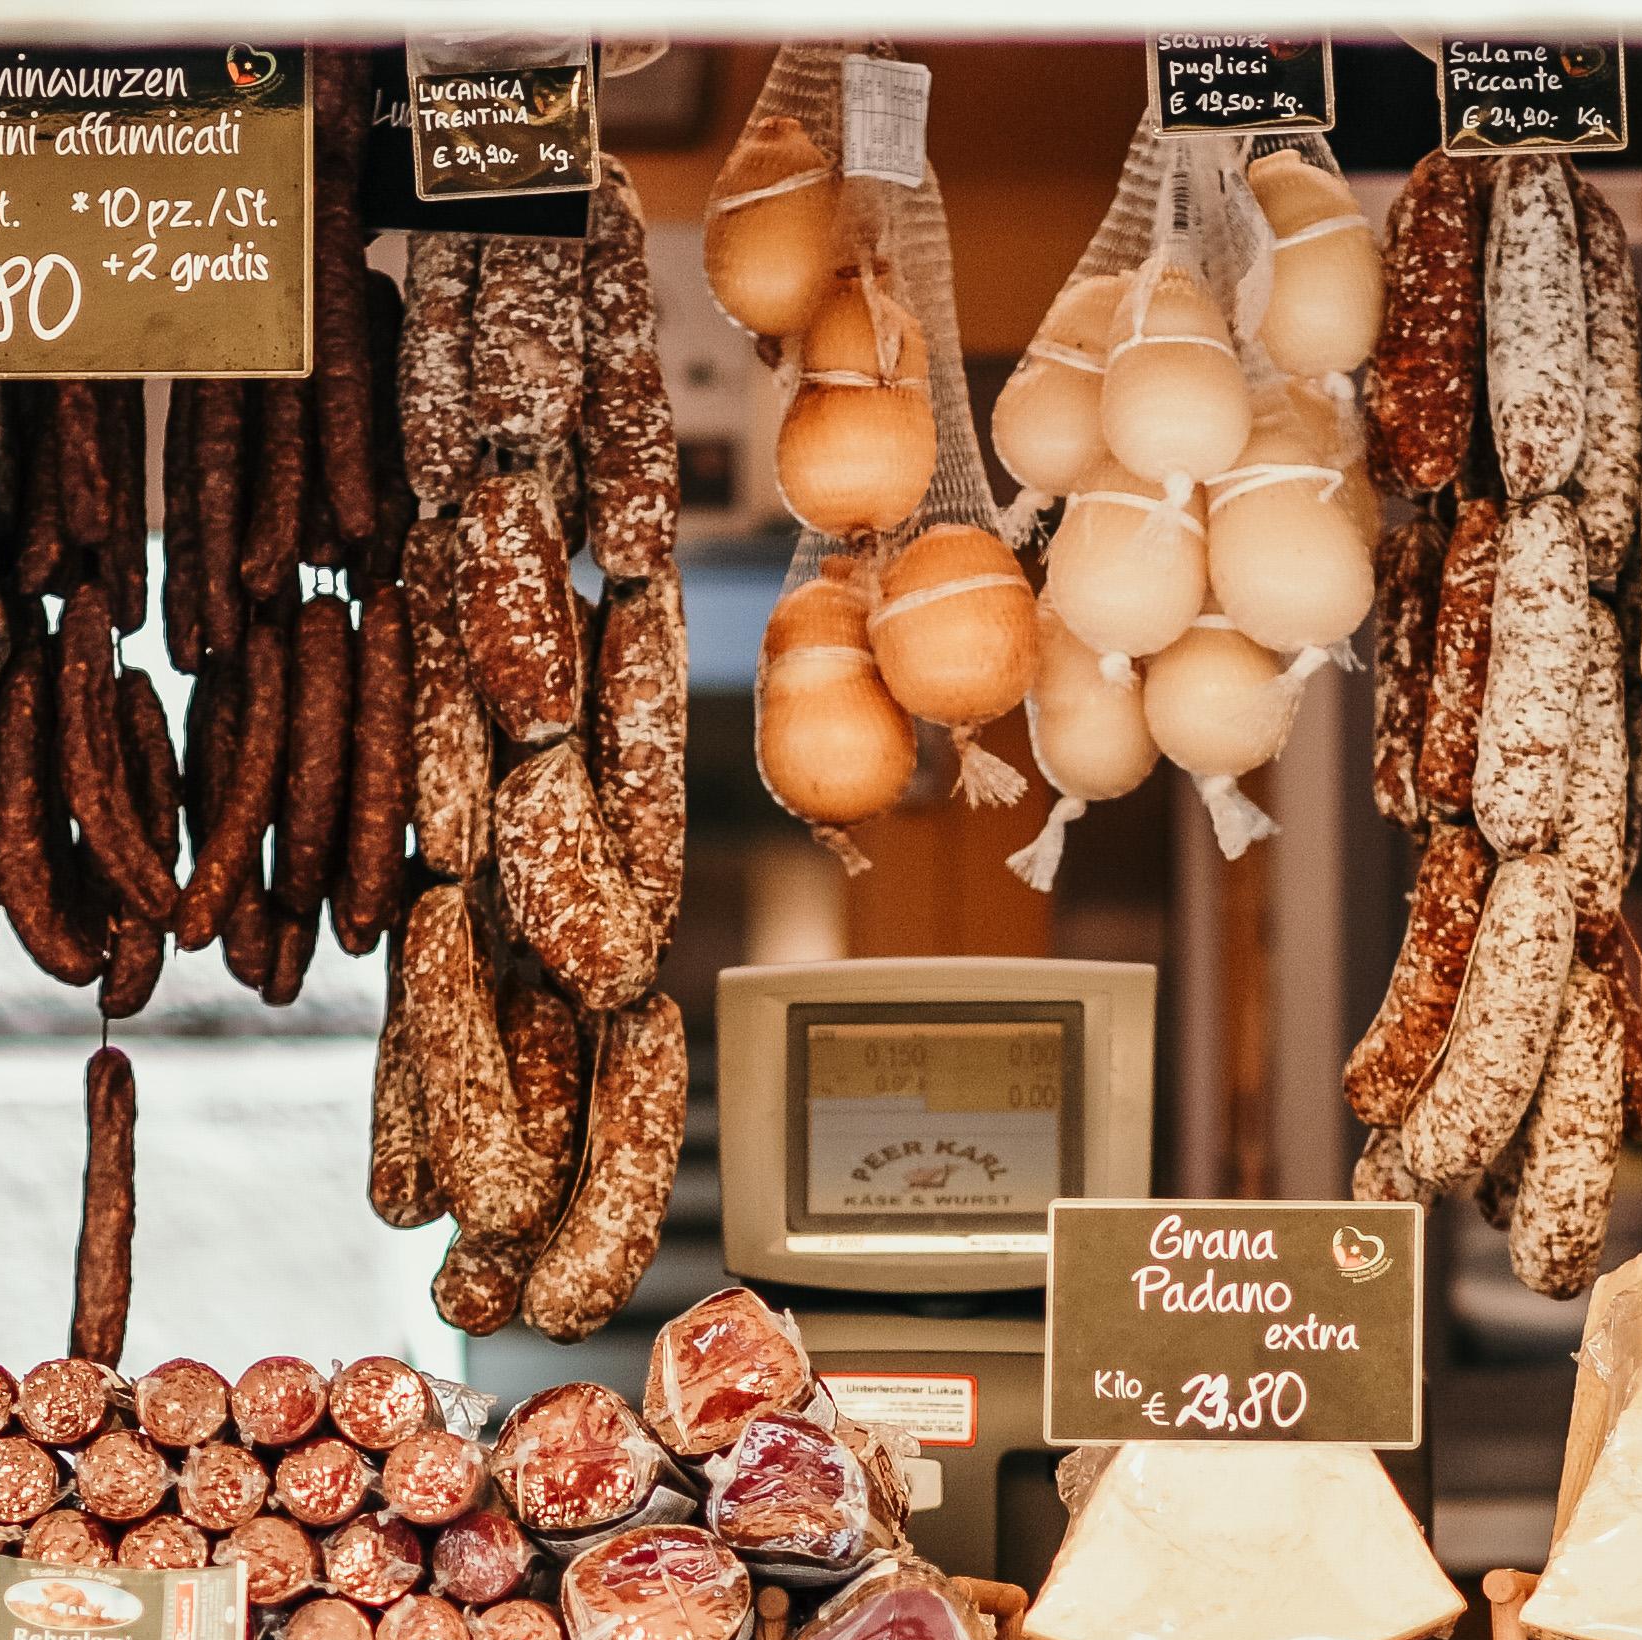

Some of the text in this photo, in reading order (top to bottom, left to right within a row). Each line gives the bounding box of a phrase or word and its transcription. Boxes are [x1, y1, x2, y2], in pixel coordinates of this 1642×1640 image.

[1169, 57, 1268, 88] pugliesi
[1450, 41, 1548, 65] Salame
[1452, 69, 1563, 92] Piccante
[54, 110, 243, 156] affumicati
[170, 241, 270, 293] gratis
[1149, 1215, 1277, 1260] Grana
[1132, 1265, 1291, 1313] Padano
[1264, 1313, 1360, 1353] extra
[1095, 1369, 1143, 1400] Kilo
[1141, 1392, 1171, 1427] €
